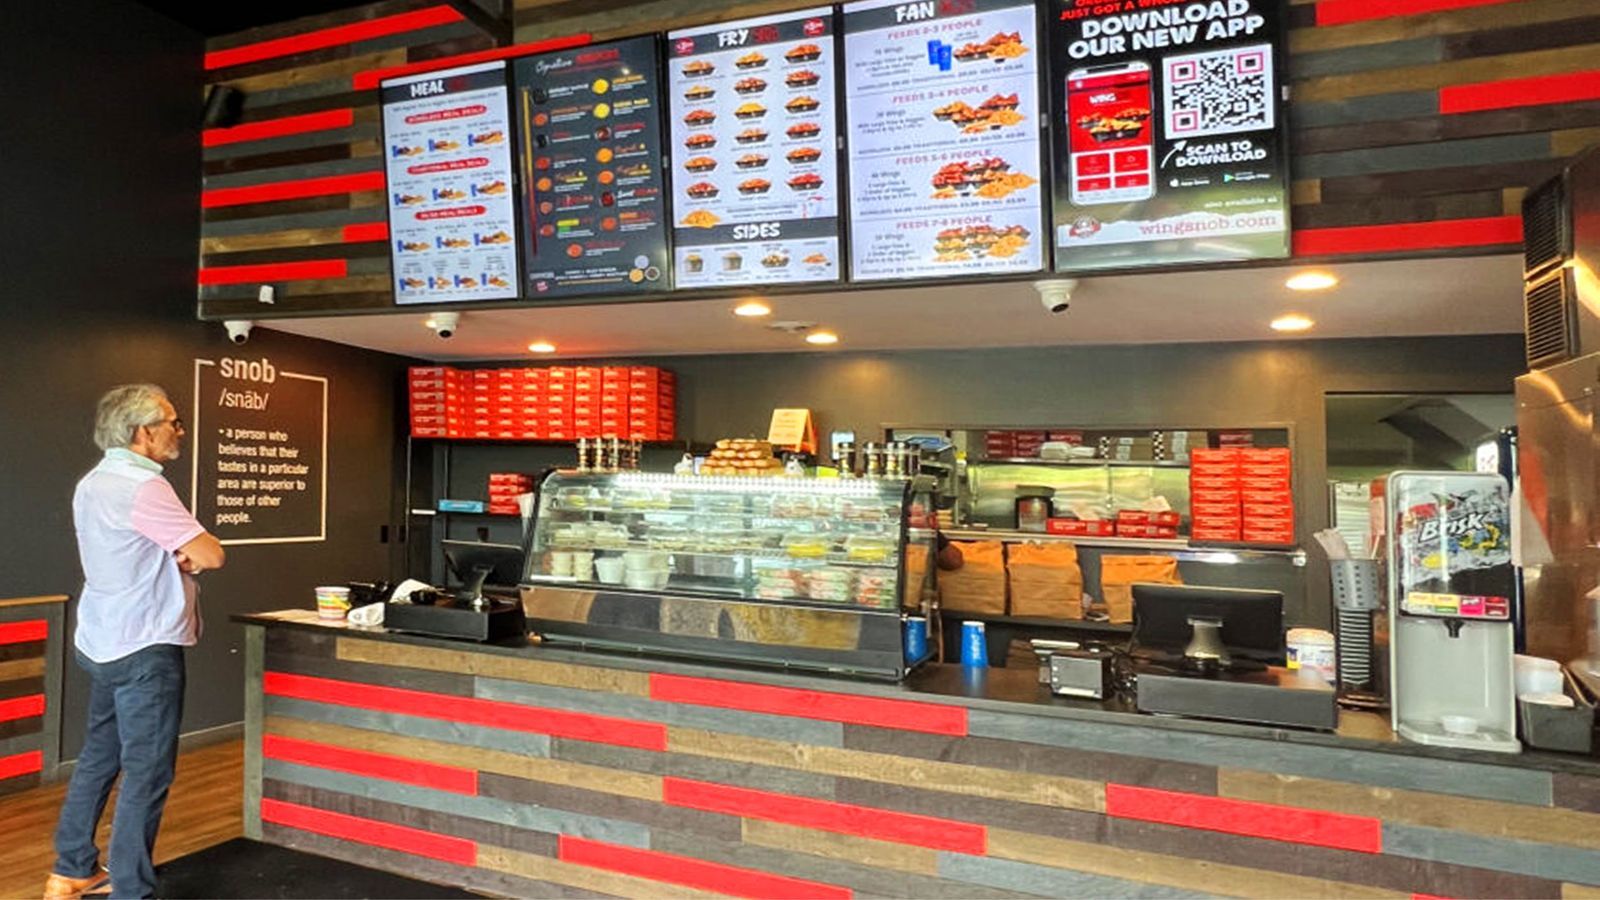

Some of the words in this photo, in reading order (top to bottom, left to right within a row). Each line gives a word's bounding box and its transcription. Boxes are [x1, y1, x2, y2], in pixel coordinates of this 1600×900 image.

[894, 1, 935, 23] FAN
[1060, 8, 1089, 20] JUST
[1093, 2, 1121, 15] GOT
[1124, 1, 1135, 10] A
[1082, 0, 1250, 38] DOWNLOAD
[941, 19, 982, 32] PEOPLE
[718, 29, 749, 48] FRY
[1068, 35, 1126, 59] OUR
[1132, 25, 1198, 50] NEW
[1205, 15, 1264, 41] APP
[410, 79, 445, 98] MEAL
[947, 85, 989, 97] PEOPLE
[950, 148, 990, 160] PEOPLE
[1186, 142, 1228, 157] SCAN
[1230, 140, 1252, 151] TO
[1175, 148, 1267, 168] DOWNLOAD
[950, 214, 992, 225] PEOPLE
[1139, 215, 1277, 235] wingsnob.com
[733, 222, 781, 240] SIDES
[220, 357, 276, 384] snob
[225, 428, 234, 438] a
[234, 428, 267, 440] person
[269, 430, 289, 442] who
[218, 442, 258, 457] believes
[259, 445, 278, 457] that
[279, 446, 299, 458] their
[218, 460, 248, 473] tastes
[249, 461, 258, 473] in
[260, 464, 267, 473] a
[268, 463, 309, 475] particular
[217, 479, 240, 490] area
[241, 480, 257, 490] are
[259, 479, 295, 492] superior
[296, 479, 306, 490] to
[217, 494, 244, 507] those
[245, 494, 256, 506] of
[257, 494, 282, 507] other
[216, 511, 252, 526] people.
[1419, 512, 1484, 541] Brisk
